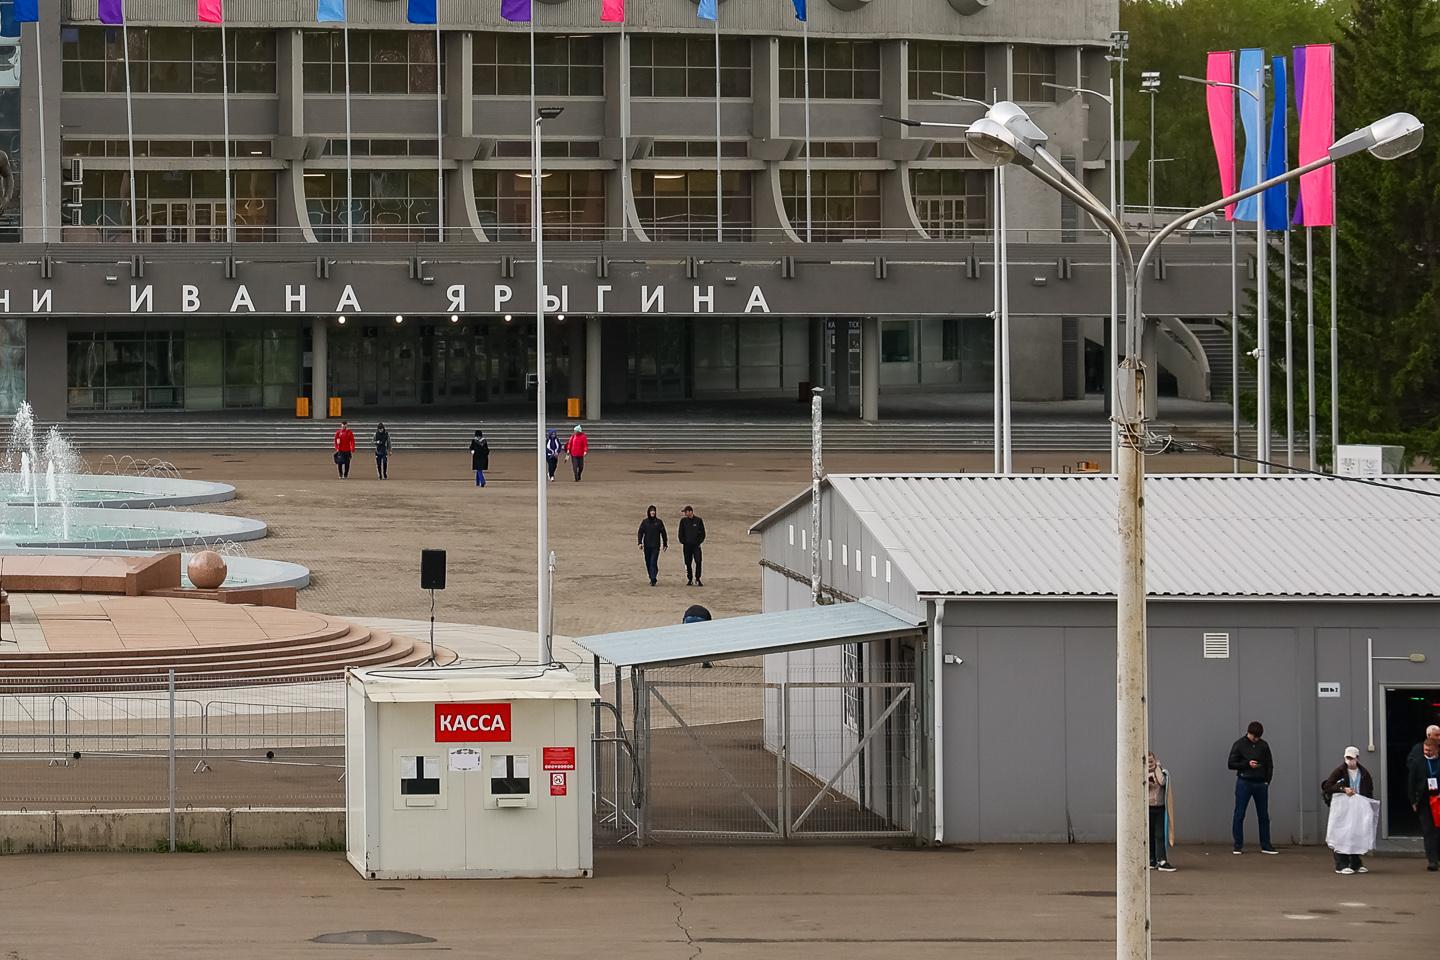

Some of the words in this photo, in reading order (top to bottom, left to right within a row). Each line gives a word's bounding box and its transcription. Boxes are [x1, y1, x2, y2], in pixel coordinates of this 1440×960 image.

[131, 284, 361, 312] ИВАНА
[446, 284, 771, 312] ЯРЫГИНА
[440, 714, 505, 732] КАССА
